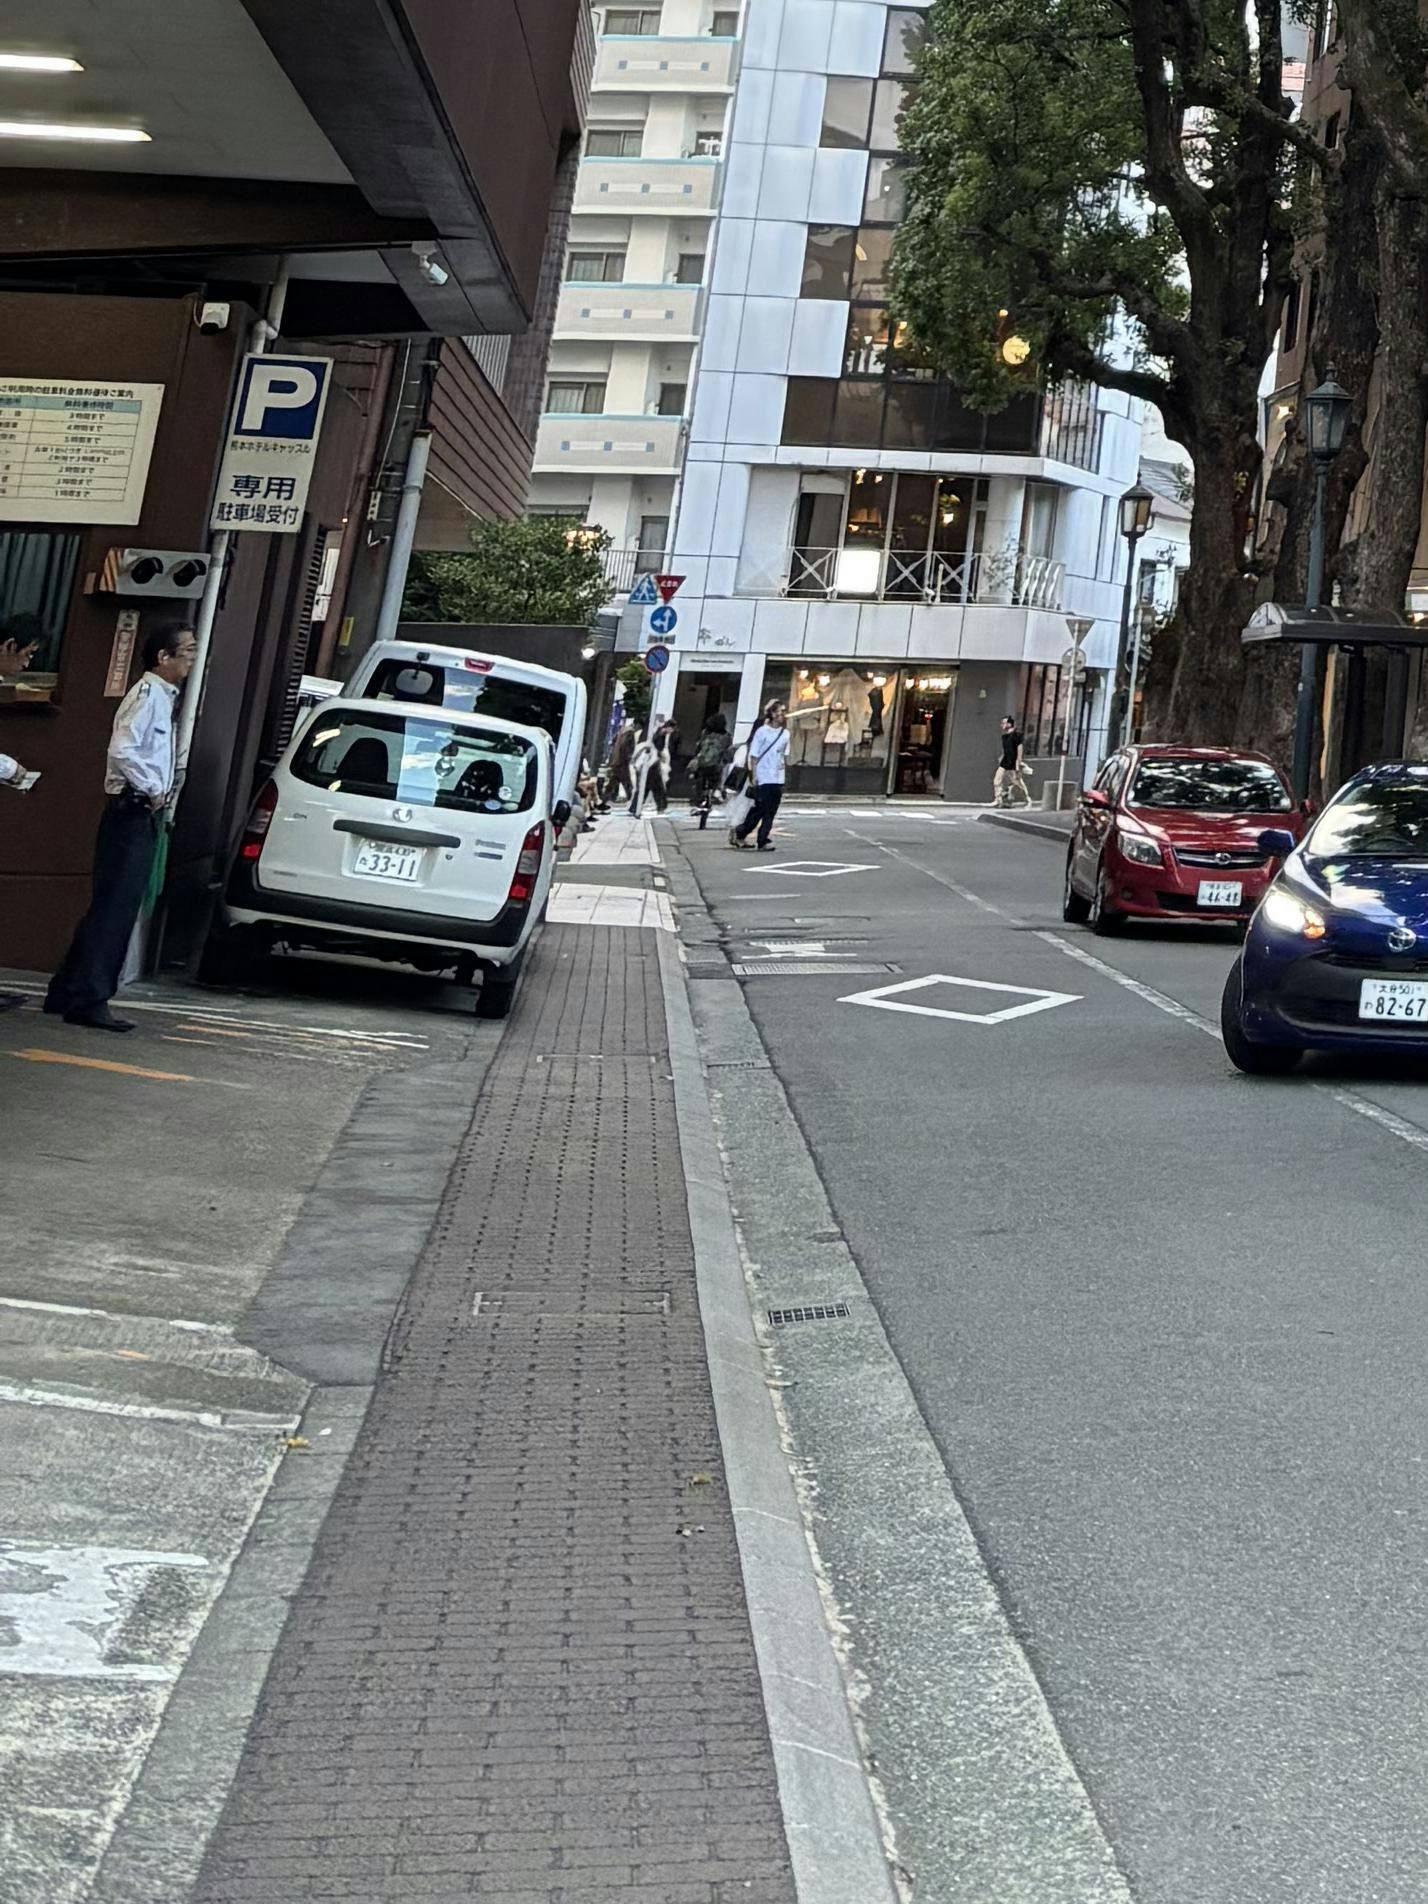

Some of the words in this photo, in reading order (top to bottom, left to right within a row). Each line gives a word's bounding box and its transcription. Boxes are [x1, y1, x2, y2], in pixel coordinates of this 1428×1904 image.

[240, 364, 317, 431] P
[229, 474, 297, 501] 専用
[216, 502, 301, 526] 駐車場受付
[368, 853, 416, 877] 33-11
